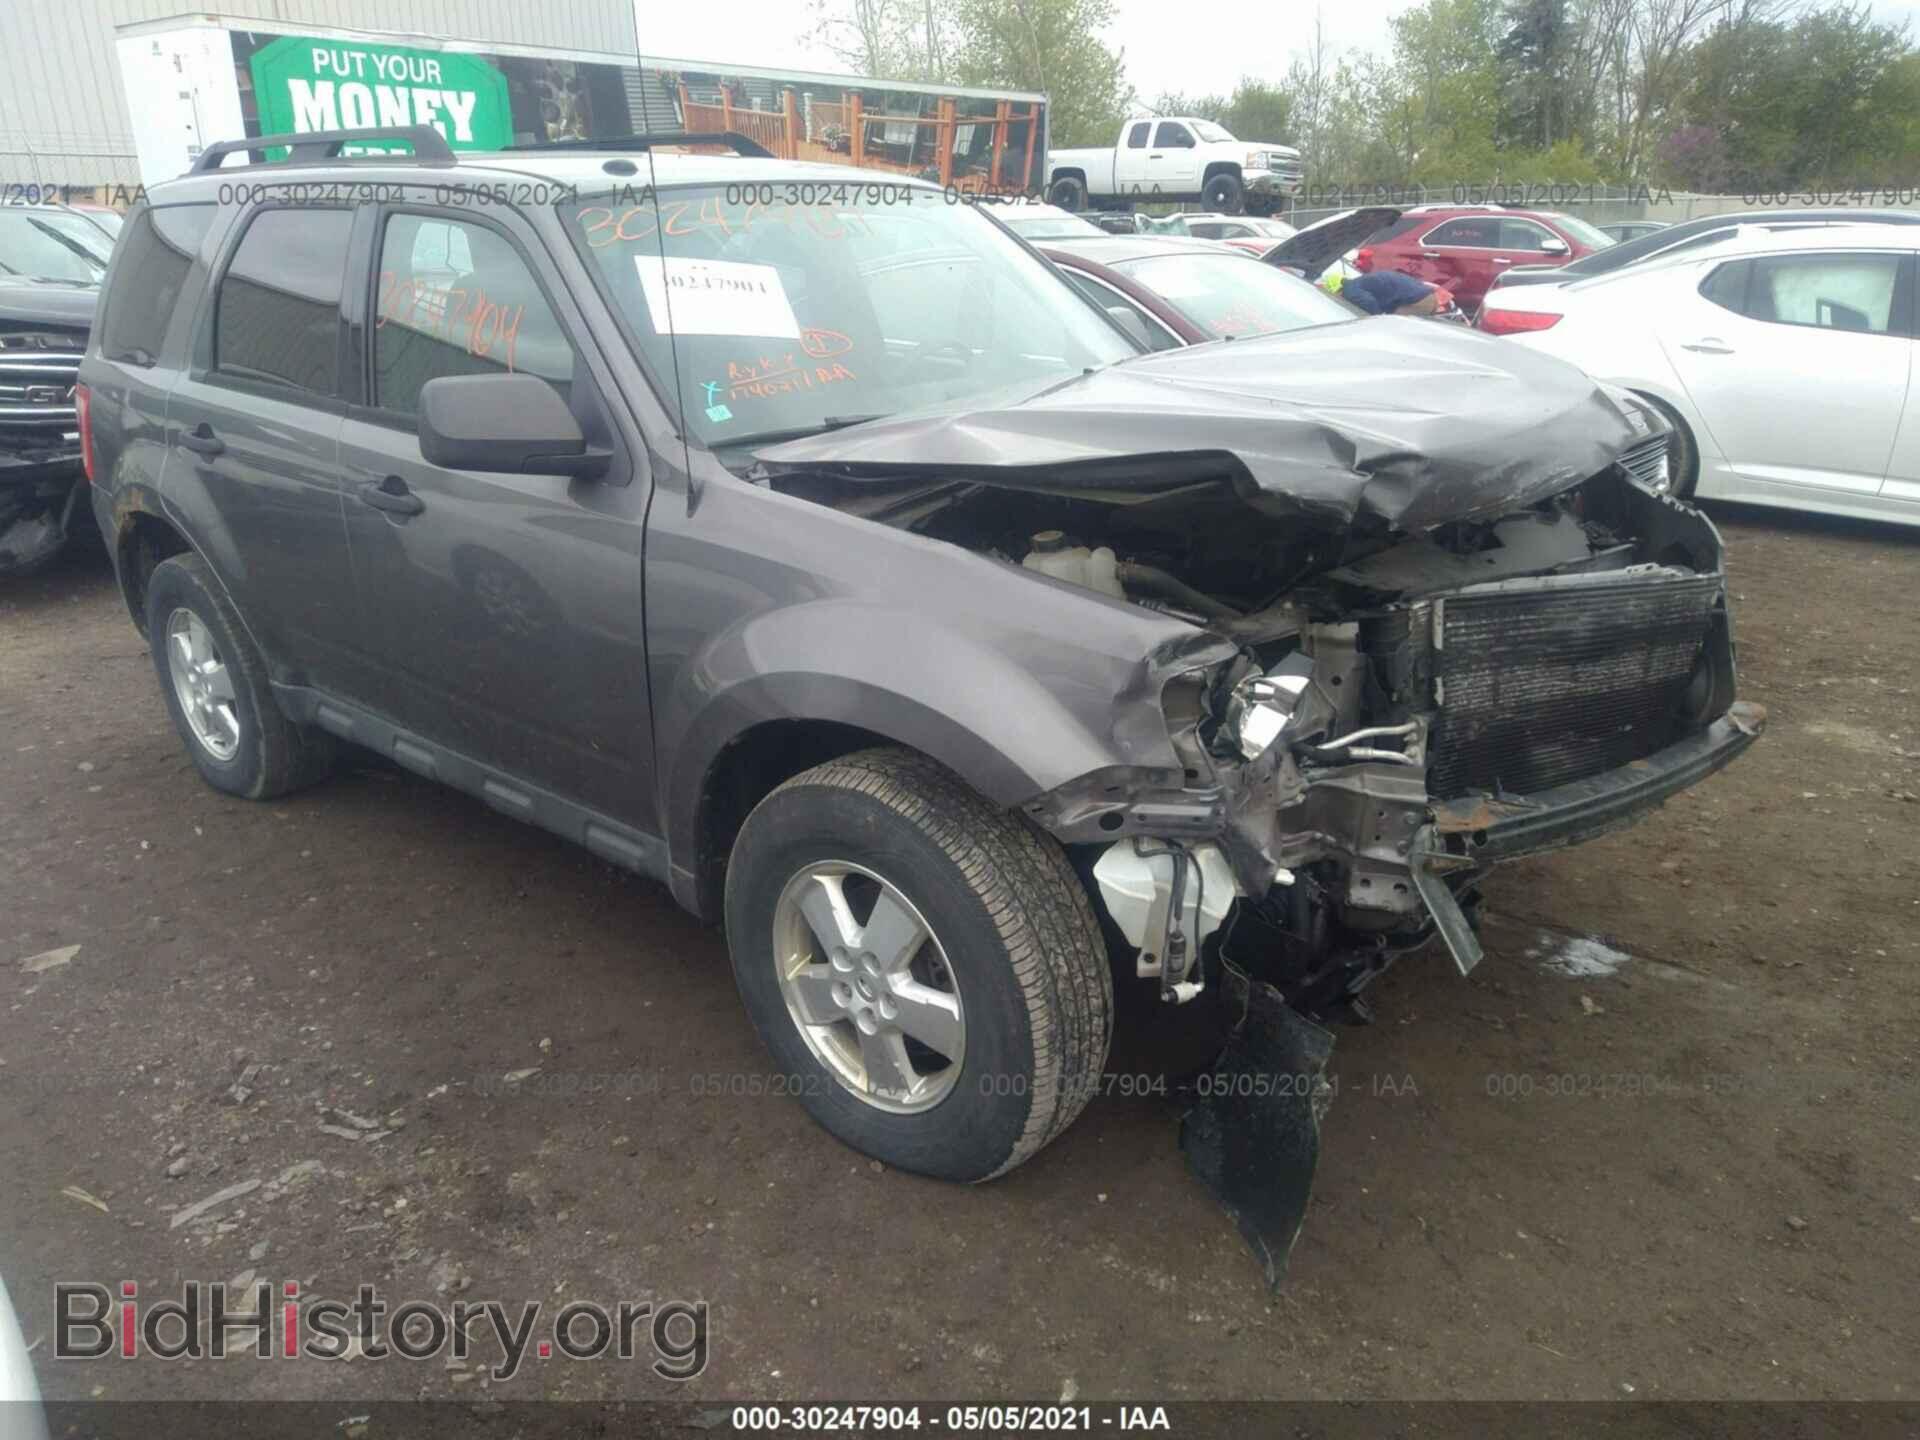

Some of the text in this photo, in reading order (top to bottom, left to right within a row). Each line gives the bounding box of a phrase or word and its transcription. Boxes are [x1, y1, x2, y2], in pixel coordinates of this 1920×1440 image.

[311, 47, 443, 85] PUT YOUR
[287, 78, 477, 142] MONEY
